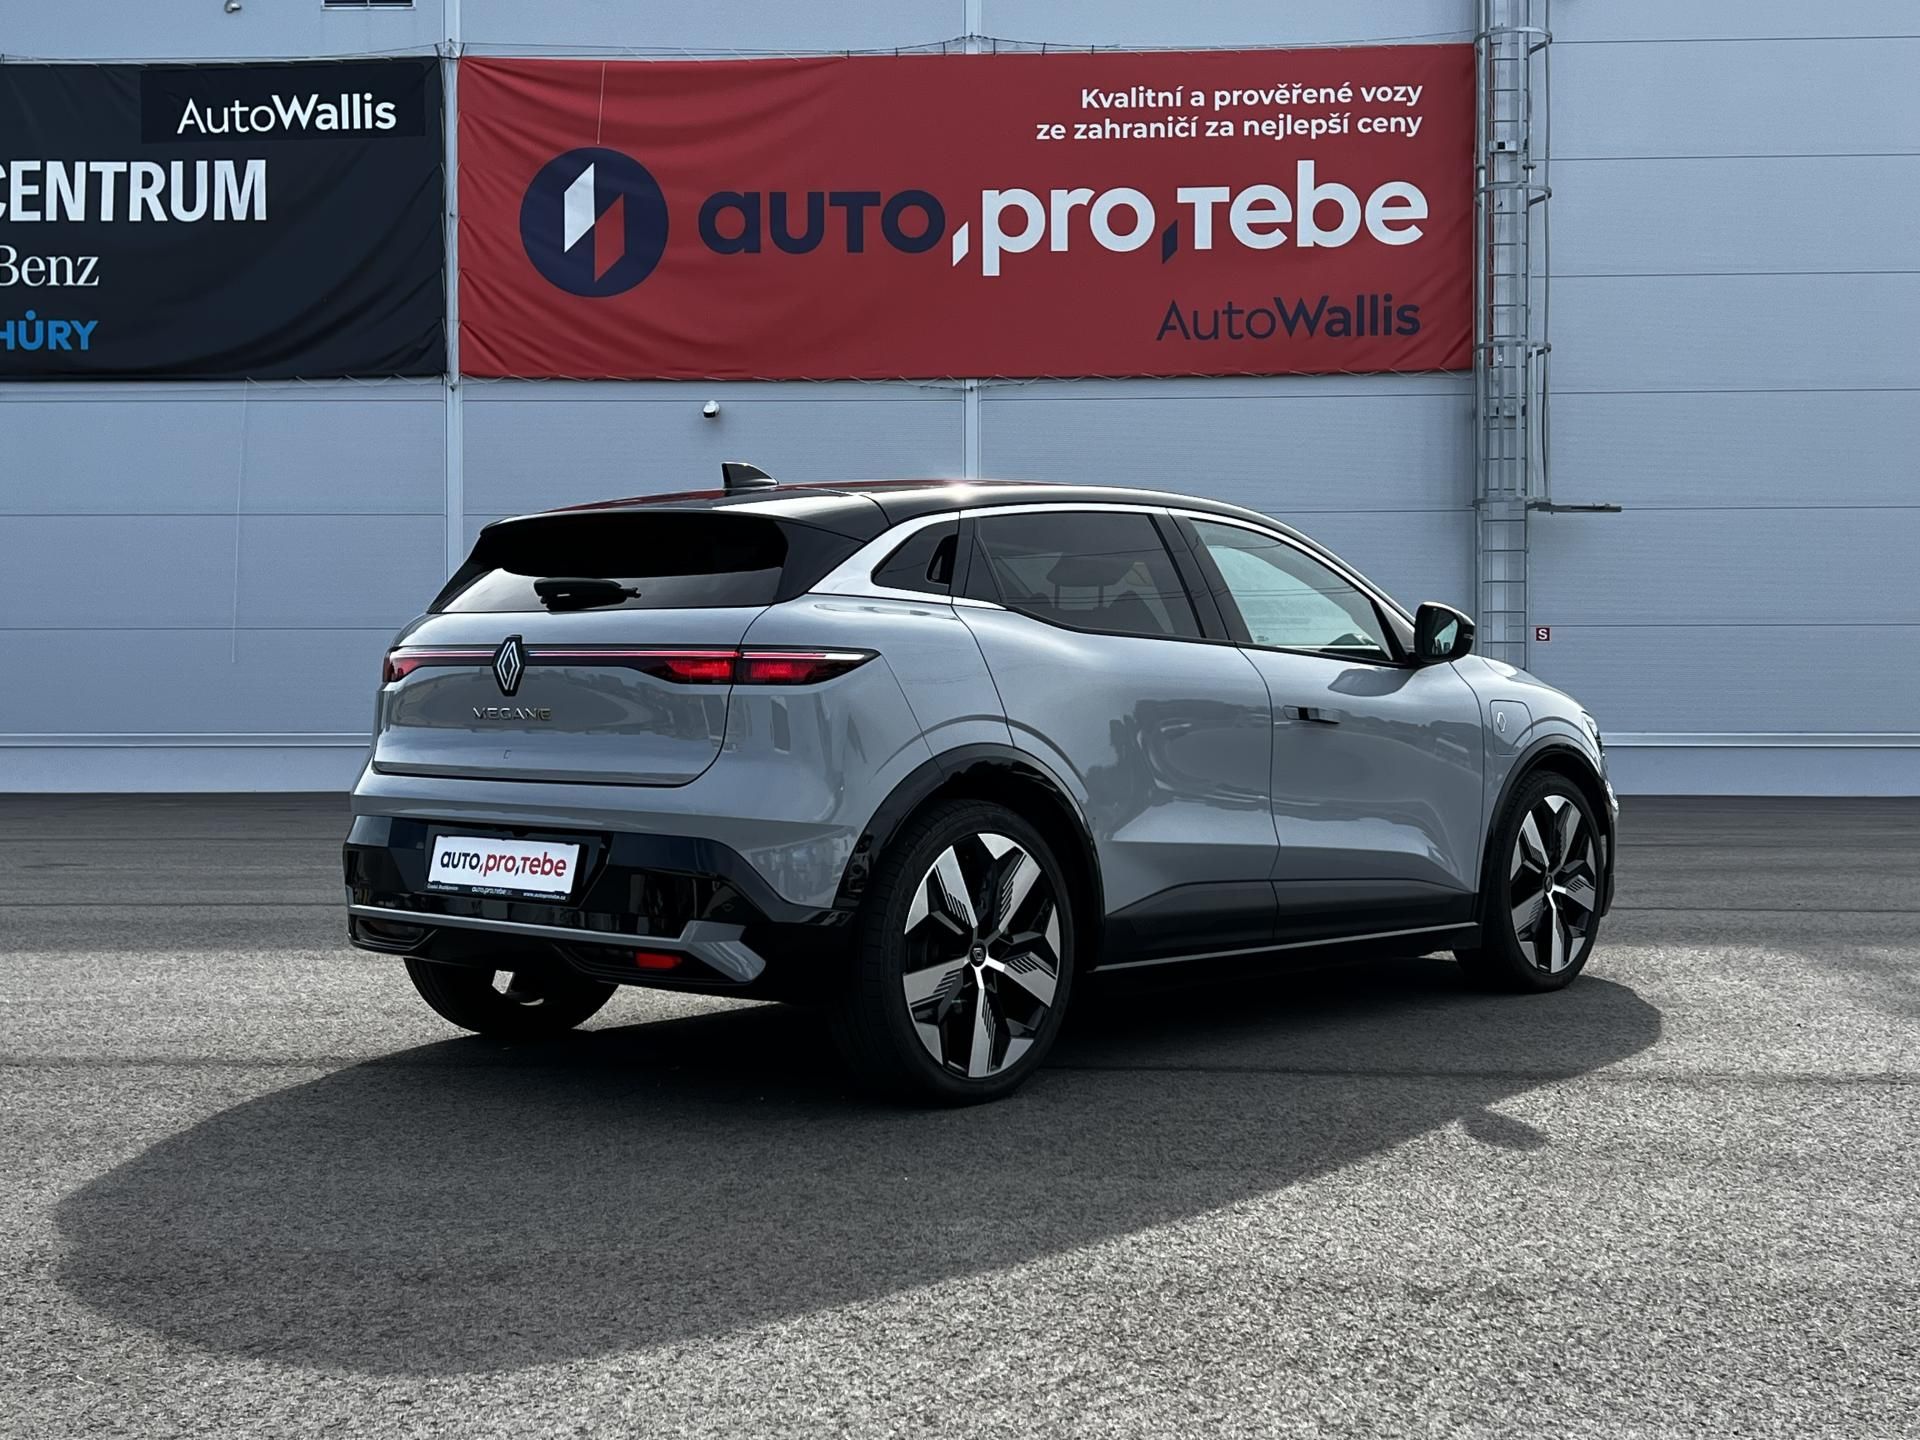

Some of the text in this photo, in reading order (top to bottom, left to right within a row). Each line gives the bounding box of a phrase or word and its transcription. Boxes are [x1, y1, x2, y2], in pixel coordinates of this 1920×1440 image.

[176, 92, 397, 135] AutoWallis
[1081, 83, 1423, 111] Kvalitní a prověřené vozy
[1036, 112, 1423, 141] ze zahraničí za nejlepší ceny
[0, 159, 267, 222] ENTRUM
[0, 244, 99, 287] Benz
[1156, 293, 1421, 341] AutoWallis
[1538, 628, 1548, 640] S
